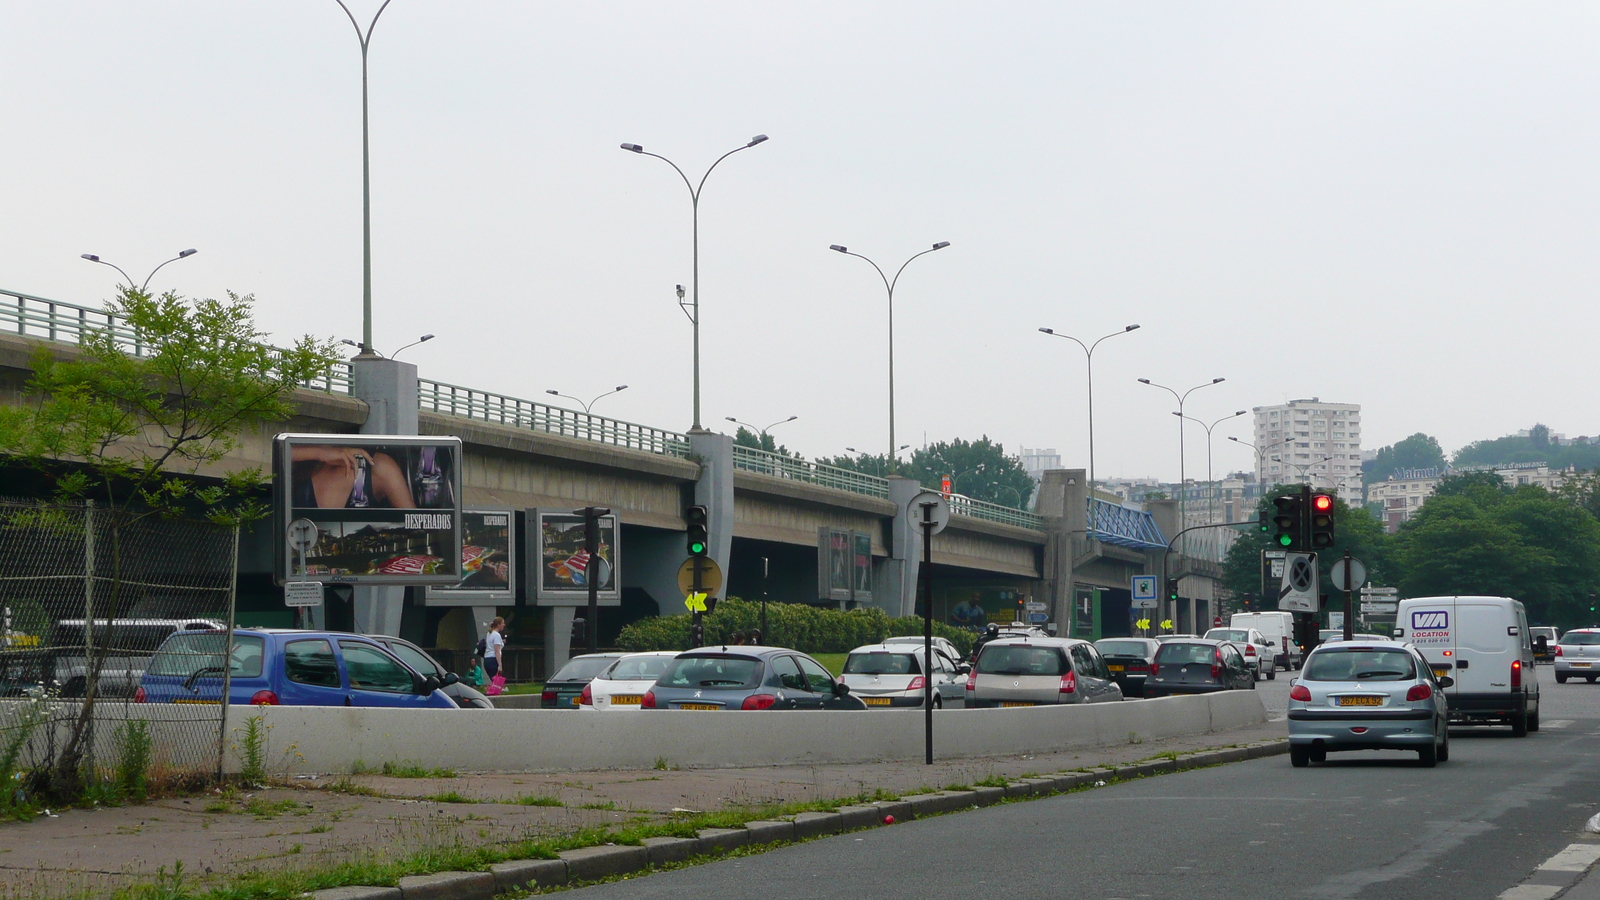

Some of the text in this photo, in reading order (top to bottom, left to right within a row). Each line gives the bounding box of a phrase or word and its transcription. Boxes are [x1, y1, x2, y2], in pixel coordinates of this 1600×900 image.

[1393, 466, 1438, 479] Matmut
[1477, 463, 1507, 471] mutuelle
[1508, 461, 1547, 469] d'assurance
[404, 514, 452, 530] DESPERADOS
[484, 516, 507, 526] DESPERADOS
[1414, 613, 1446, 628] VIA
[1340, 697, 1382, 705] 367 ECX 92
